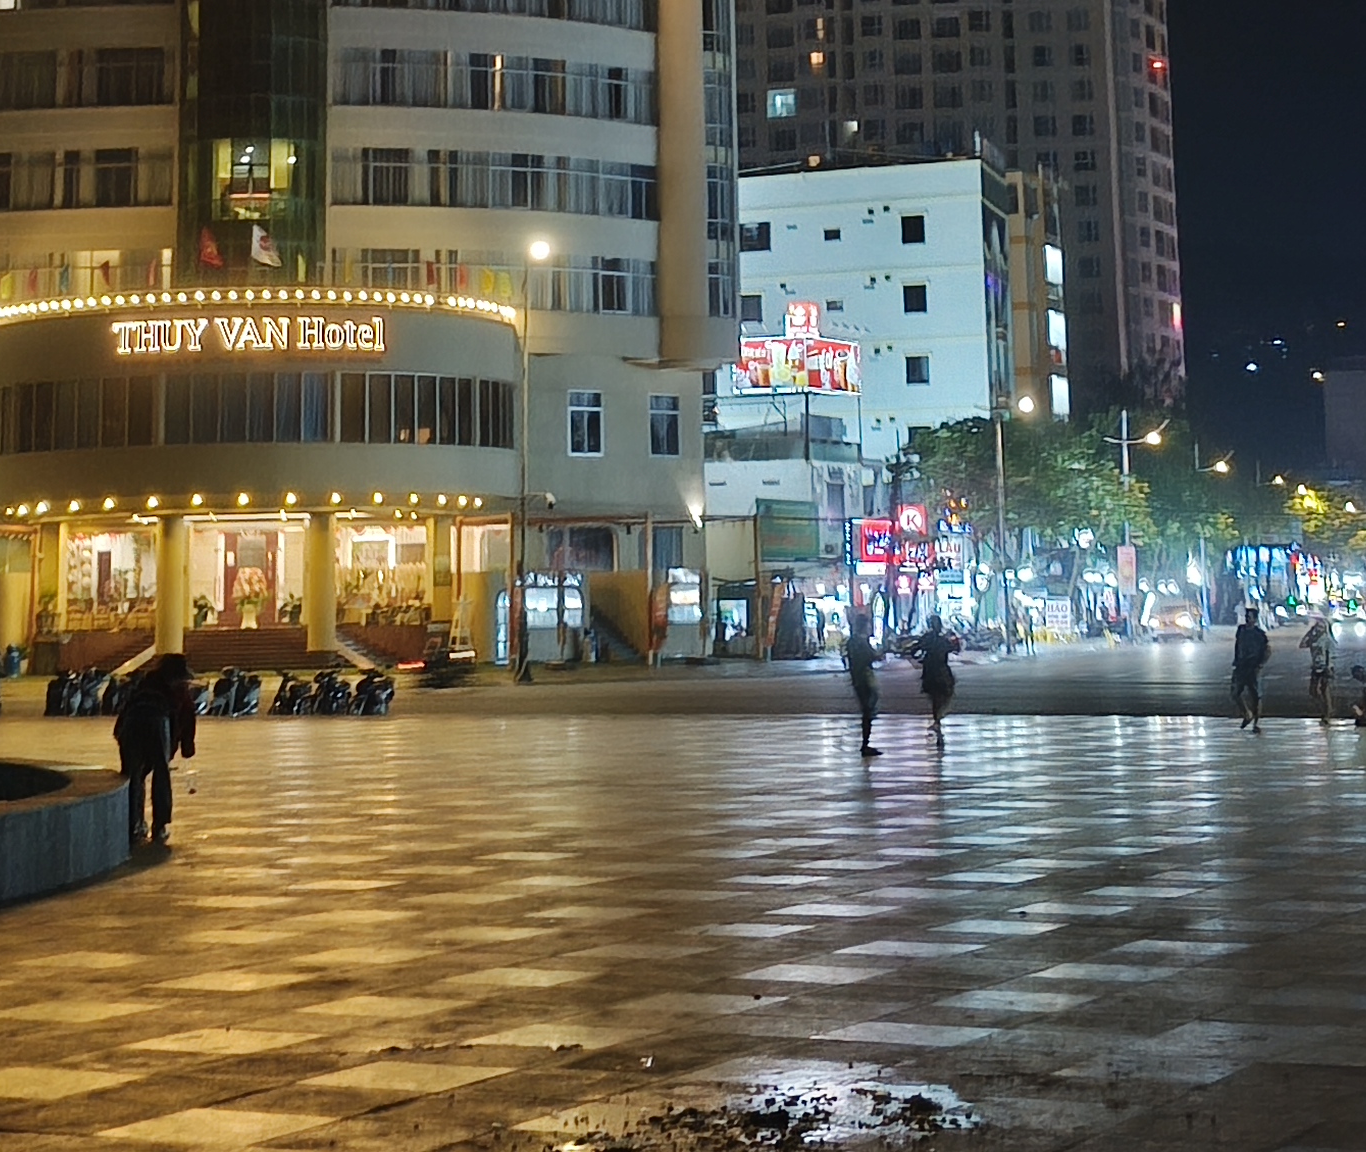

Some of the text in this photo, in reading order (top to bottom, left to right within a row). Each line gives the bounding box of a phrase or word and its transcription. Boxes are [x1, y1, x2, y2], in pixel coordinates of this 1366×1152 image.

[112, 316, 386, 355] THUY VAN Hotel
